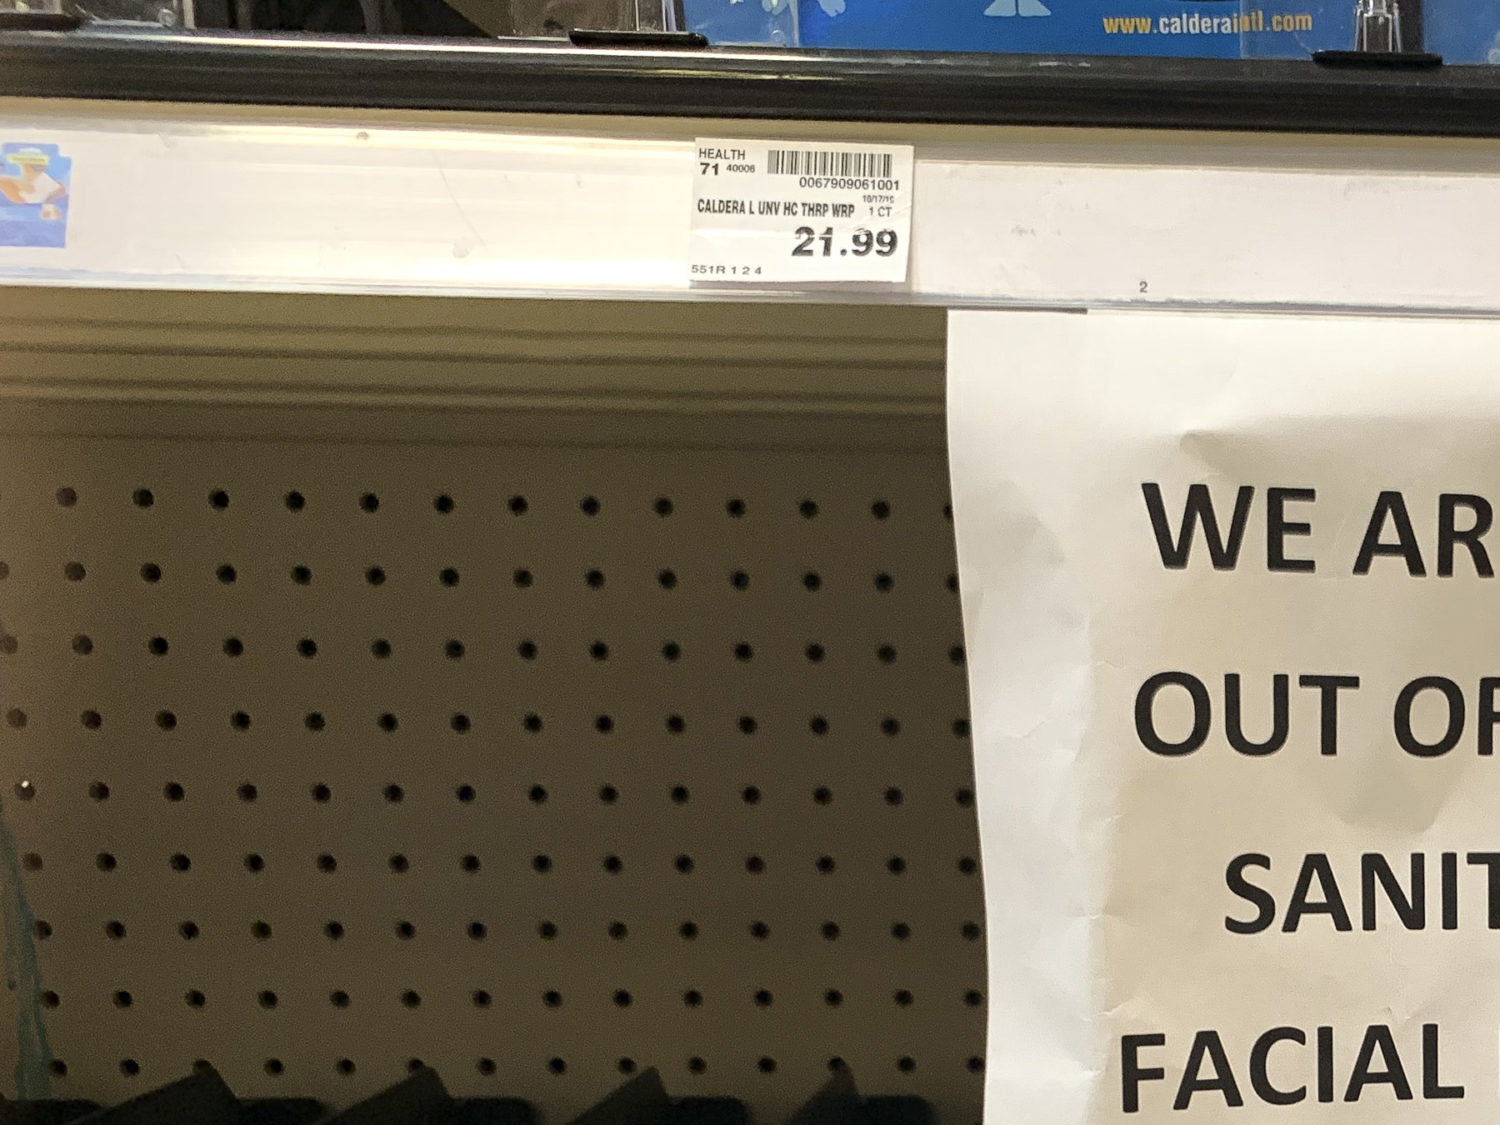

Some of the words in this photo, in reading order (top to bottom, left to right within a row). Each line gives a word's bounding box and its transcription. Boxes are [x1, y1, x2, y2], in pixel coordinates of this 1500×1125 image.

[1103, 10, 1312, 34] www.calderaintl.com
[699, 149, 745, 160] HEALTH
[700, 163, 719, 175] 71
[800, 177, 899, 190] 0067909061001
[698, 199, 745, 213] CALDERA
[750, 201, 755, 213] L
[759, 202, 779, 215] UNV
[784, 202, 798, 215] HC
[802, 203, 828, 216] THRP
[832, 204, 854, 217] WRP
[878, 207, 892, 217] CT
[791, 226, 897, 257] 21.99
[691, 265, 726, 274] 551R
[742, 267, 750, 275] 2
[755, 267, 762, 275] 4
[1141, 482, 1316, 574] WE
[1134, 671, 1360, 757] OUT
[1121, 1023, 1465, 1114] FACIAL
